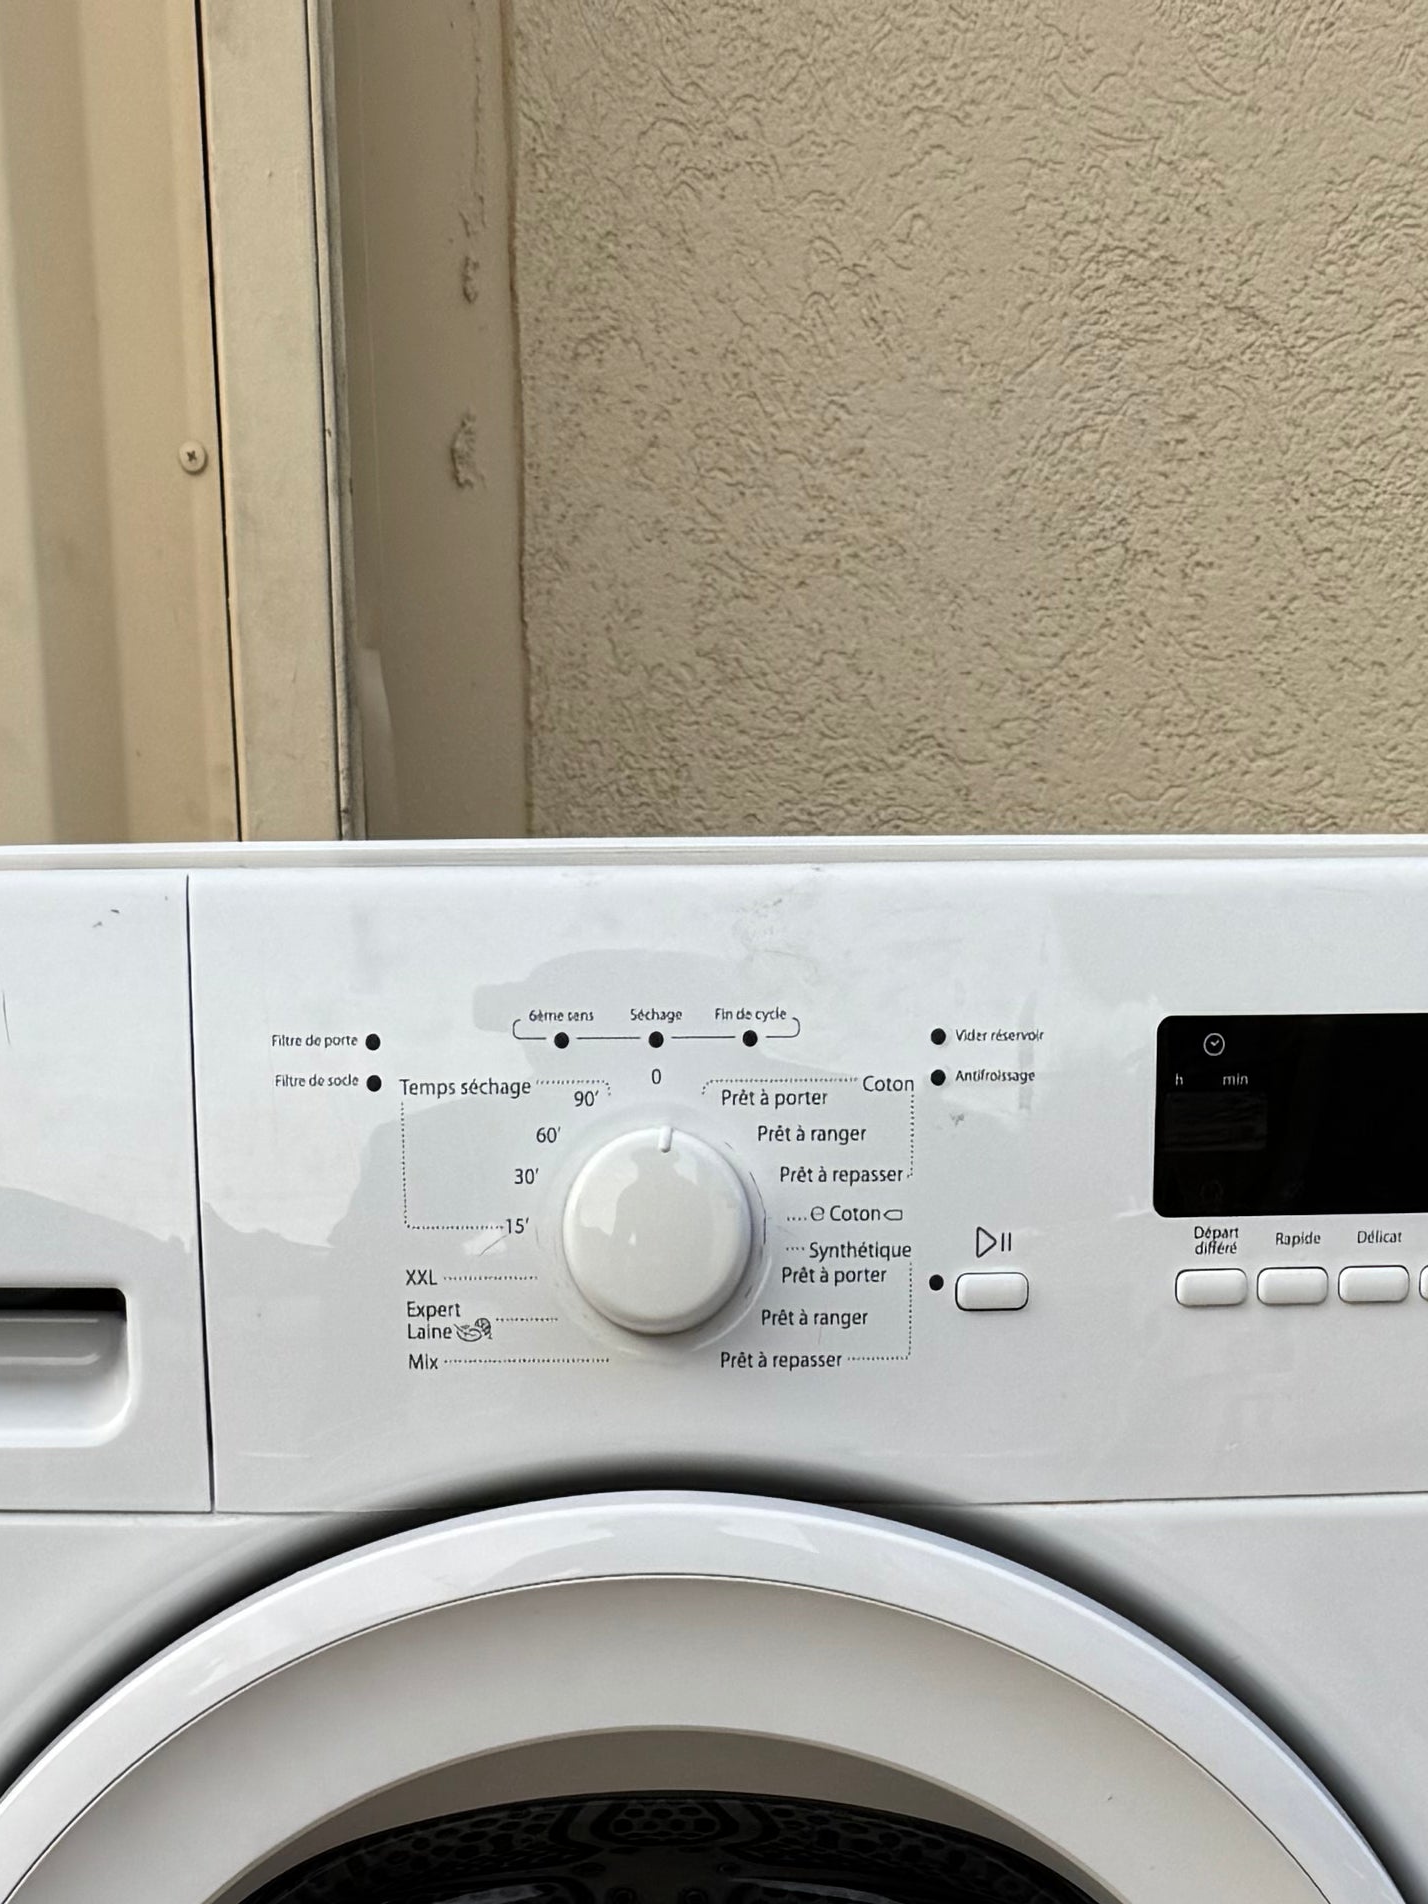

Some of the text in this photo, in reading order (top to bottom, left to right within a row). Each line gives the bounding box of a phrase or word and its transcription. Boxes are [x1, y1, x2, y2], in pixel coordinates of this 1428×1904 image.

[567, 1010, 594, 1022] sens
[629, 1008, 683, 1023] Séchage
[714, 1007, 788, 1023] Fin de cycle
[271, 1034, 359, 1049] Filtre de porte
[955, 1028, 1045, 1042] Vider réservoir
[275, 1074, 360, 1087] Filtre de socle
[862, 1075, 915, 1093] Coton
[955, 1068, 1036, 1085] Antifroissage
[1175, 1073, 1249, 1086] h min
[399, 1077, 532, 1100] Temps séchage
[721, 1088, 828, 1110] Prêt à porter
[757, 1124, 867, 1146] Prêt à ranger
[779, 1165, 904, 1187] Prêt à repasser
[829, 1205, 882, 1222] Coton
[1193, 1225, 1239, 1242] Départ
[1275, 1231, 1321, 1249] Rapide
[1356, 1230, 1403, 1245] Délicat
[809, 1241, 912, 1263] Synthétique
[1194, 1240, 1238, 1256] différé
[405, 1269, 439, 1287] XXL
[781, 1266, 887, 1287] Prêt à porter
[406, 1301, 461, 1322] Expert
[761, 1308, 869, 1330] Prêt à ranger
[407, 1323, 453, 1340] Laine
[408, 1353, 439, 1370] Mix
[720, 1350, 843, 1371] Prêt à repasser
